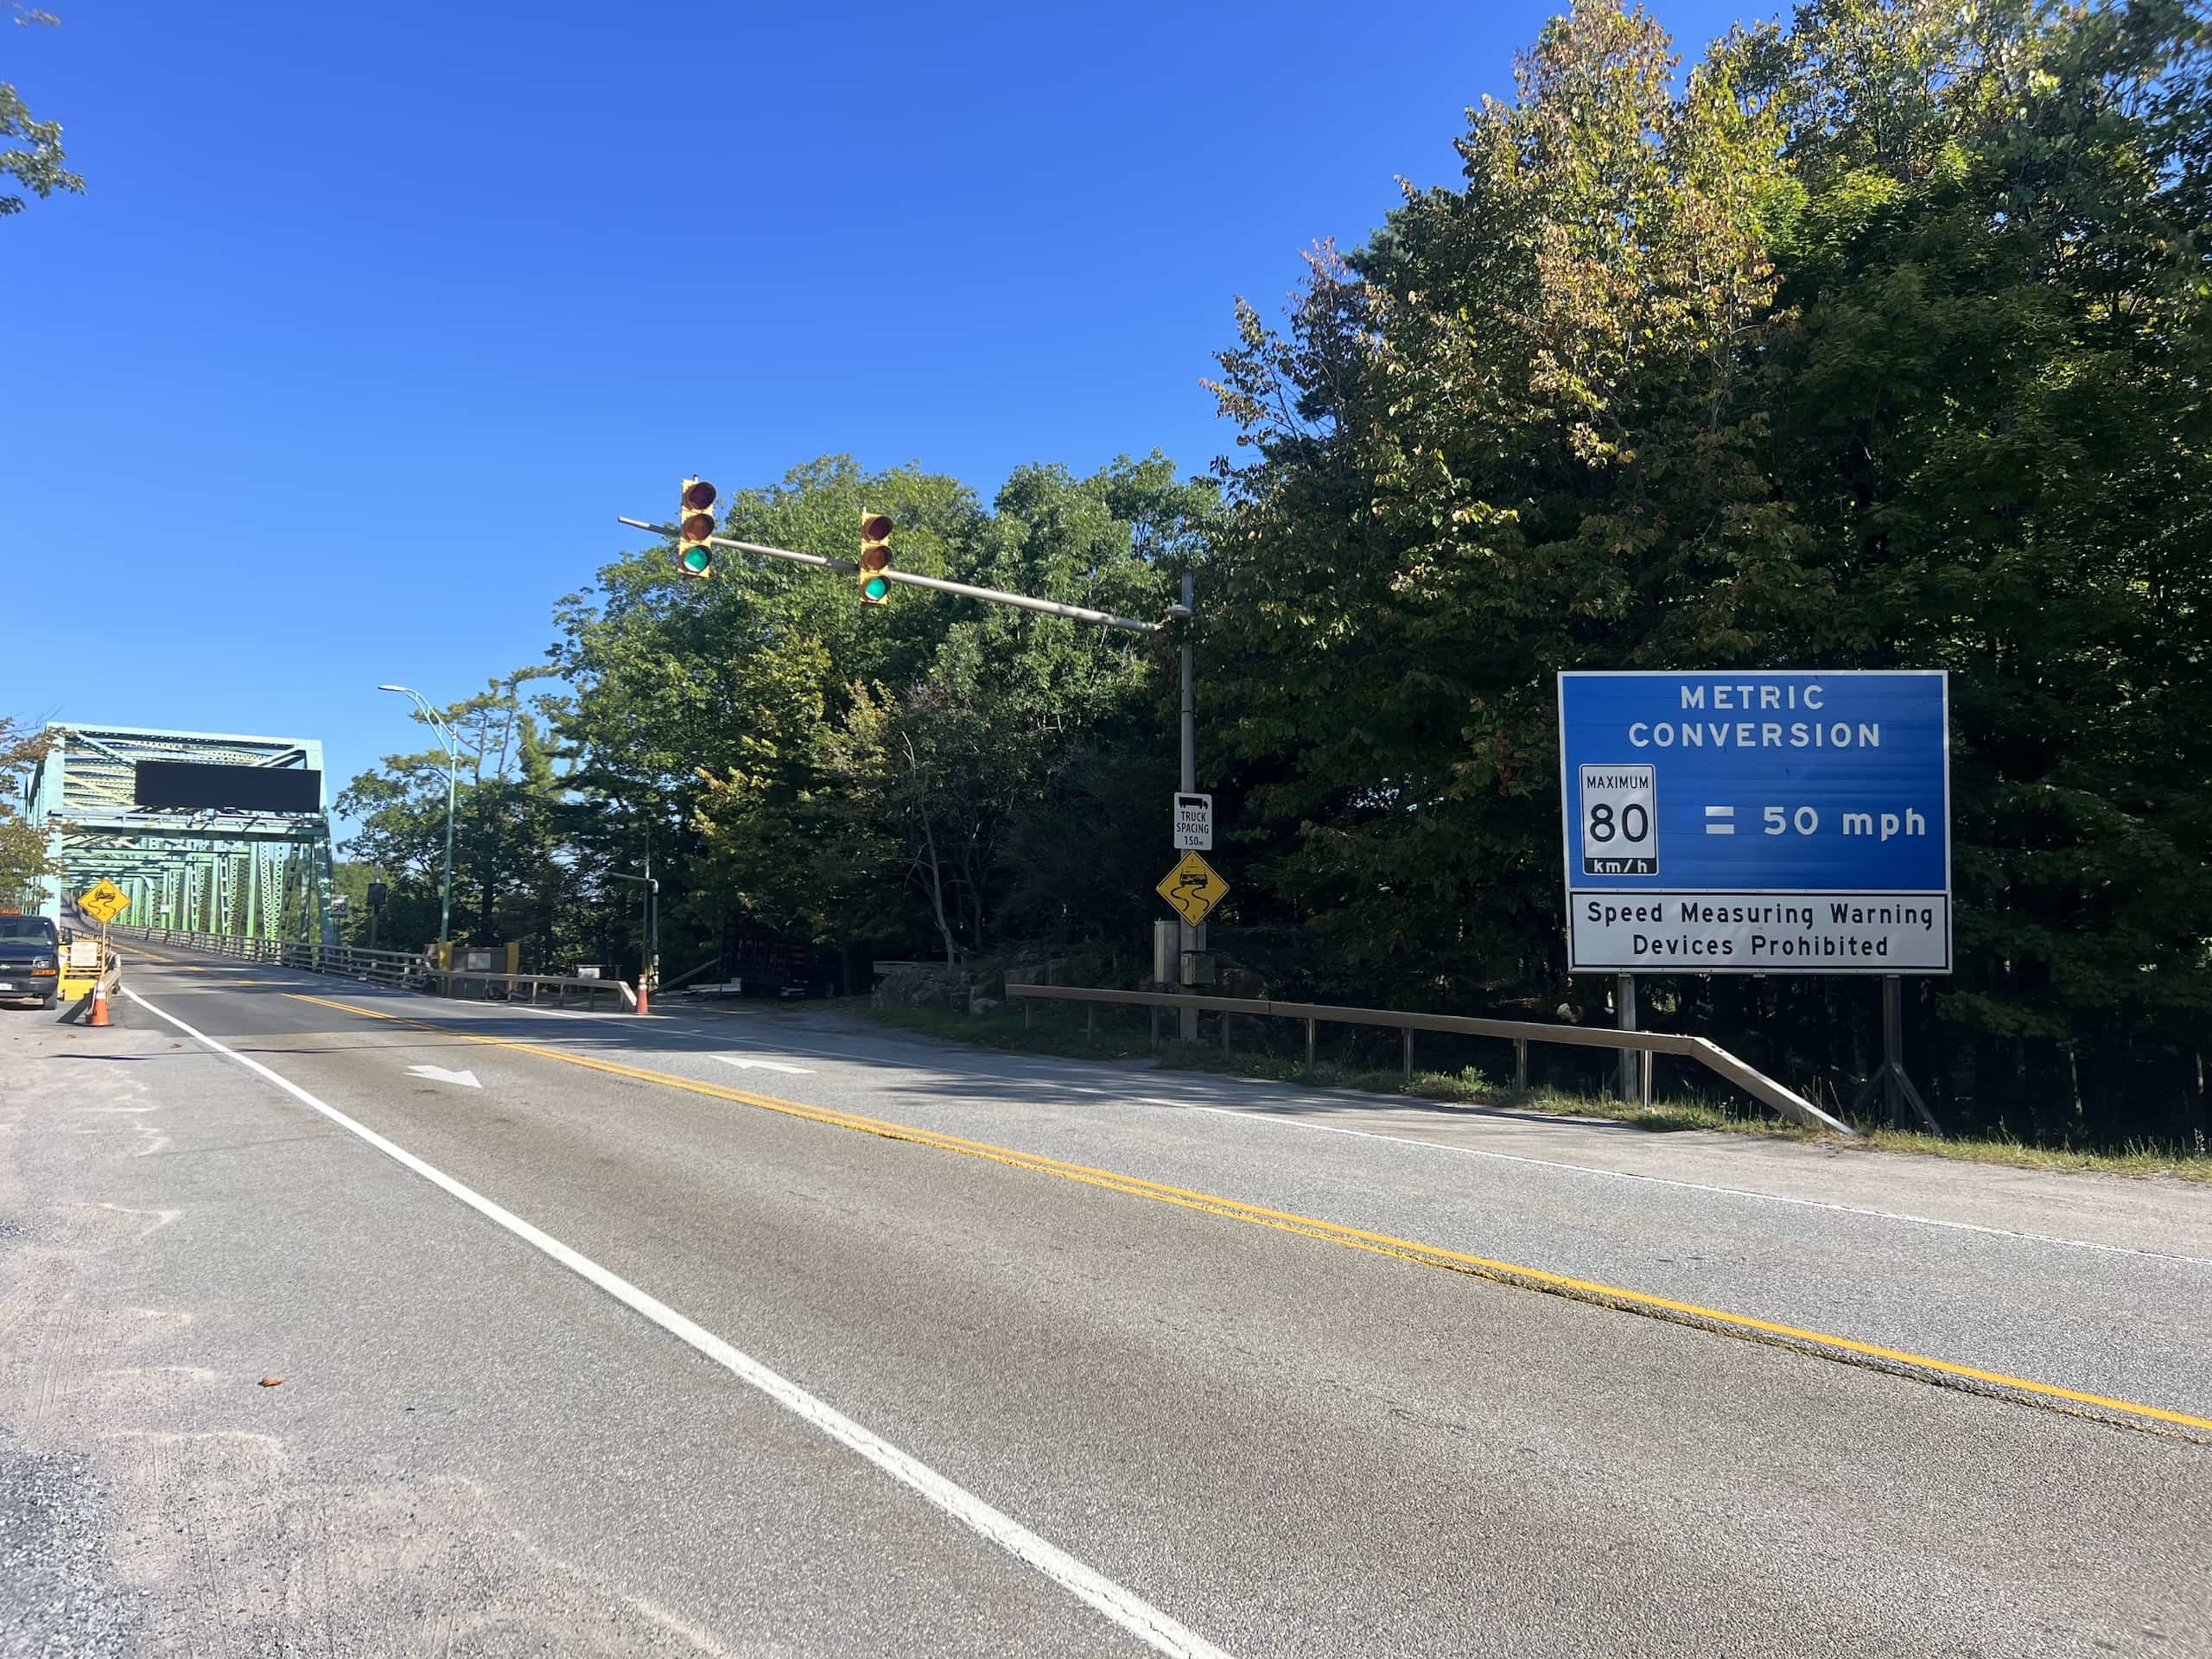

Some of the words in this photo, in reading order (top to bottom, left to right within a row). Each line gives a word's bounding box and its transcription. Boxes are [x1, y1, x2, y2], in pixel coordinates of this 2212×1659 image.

[1681, 685, 1825, 709] METRIC
[1629, 722, 1880, 747] CONVERSION
[1586, 775, 1649, 789] MAXIMUM
[1180, 810, 1206, 822] TRUCK
[1590, 803, 1649, 842] 80
[1764, 806, 1819, 836] 50
[1842, 808, 1926, 842] mph
[1176, 823, 1209, 834] SPACING
[1593, 859, 1649, 874] km/h
[332, 902, 346, 912] 50
[1587, 901, 1663, 927] Speed
[1681, 902, 1814, 930] Measuring
[1830, 903, 1933, 931] Warning
[1633, 934, 1733, 956] Devices
[1751, 934, 1889, 957] Prohibited
